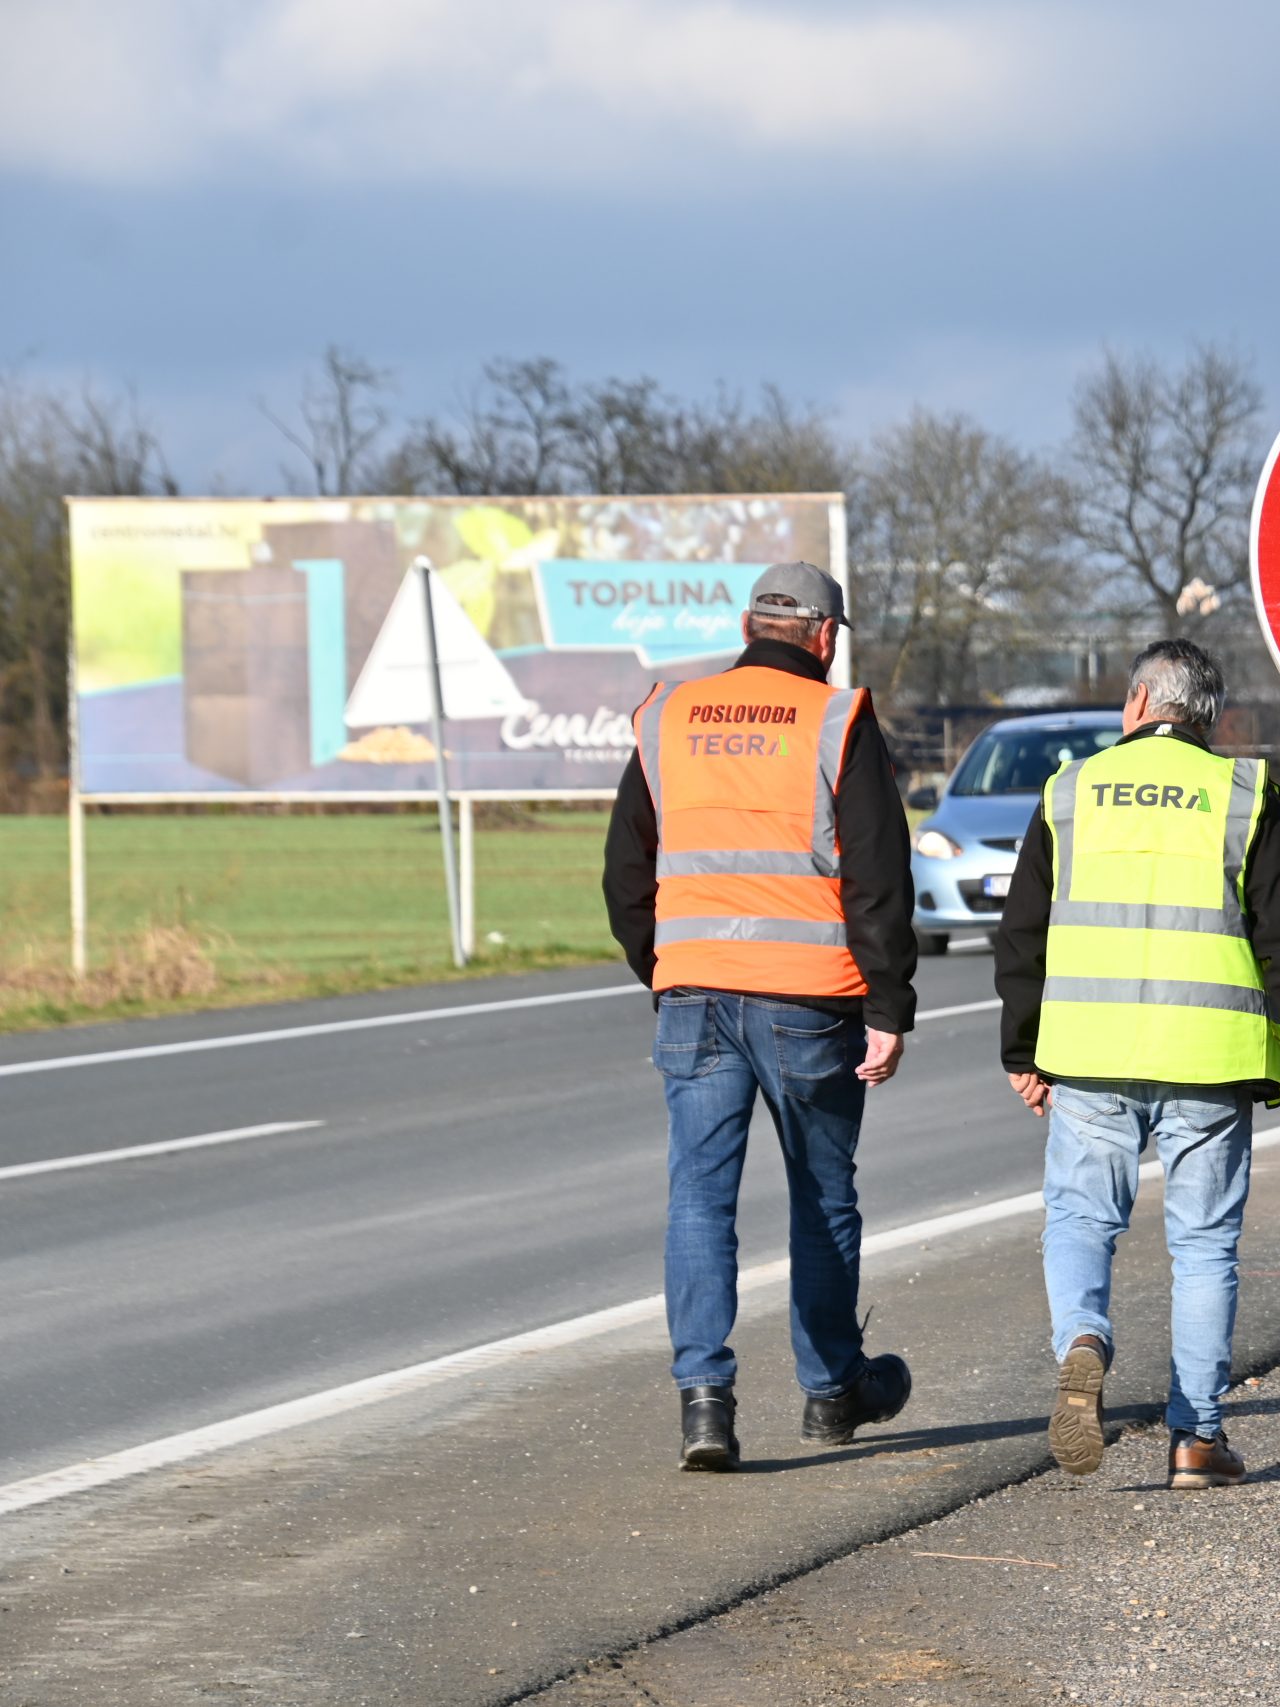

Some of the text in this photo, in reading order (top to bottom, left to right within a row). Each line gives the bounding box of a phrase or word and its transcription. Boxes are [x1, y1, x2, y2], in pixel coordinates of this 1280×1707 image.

[568, 580, 733, 606] TOPLINA
[688, 704, 797, 724] POSLOVOĐA
[687, 733, 789, 756] TEGRA
[1091, 783, 1212, 813] TEGRA
